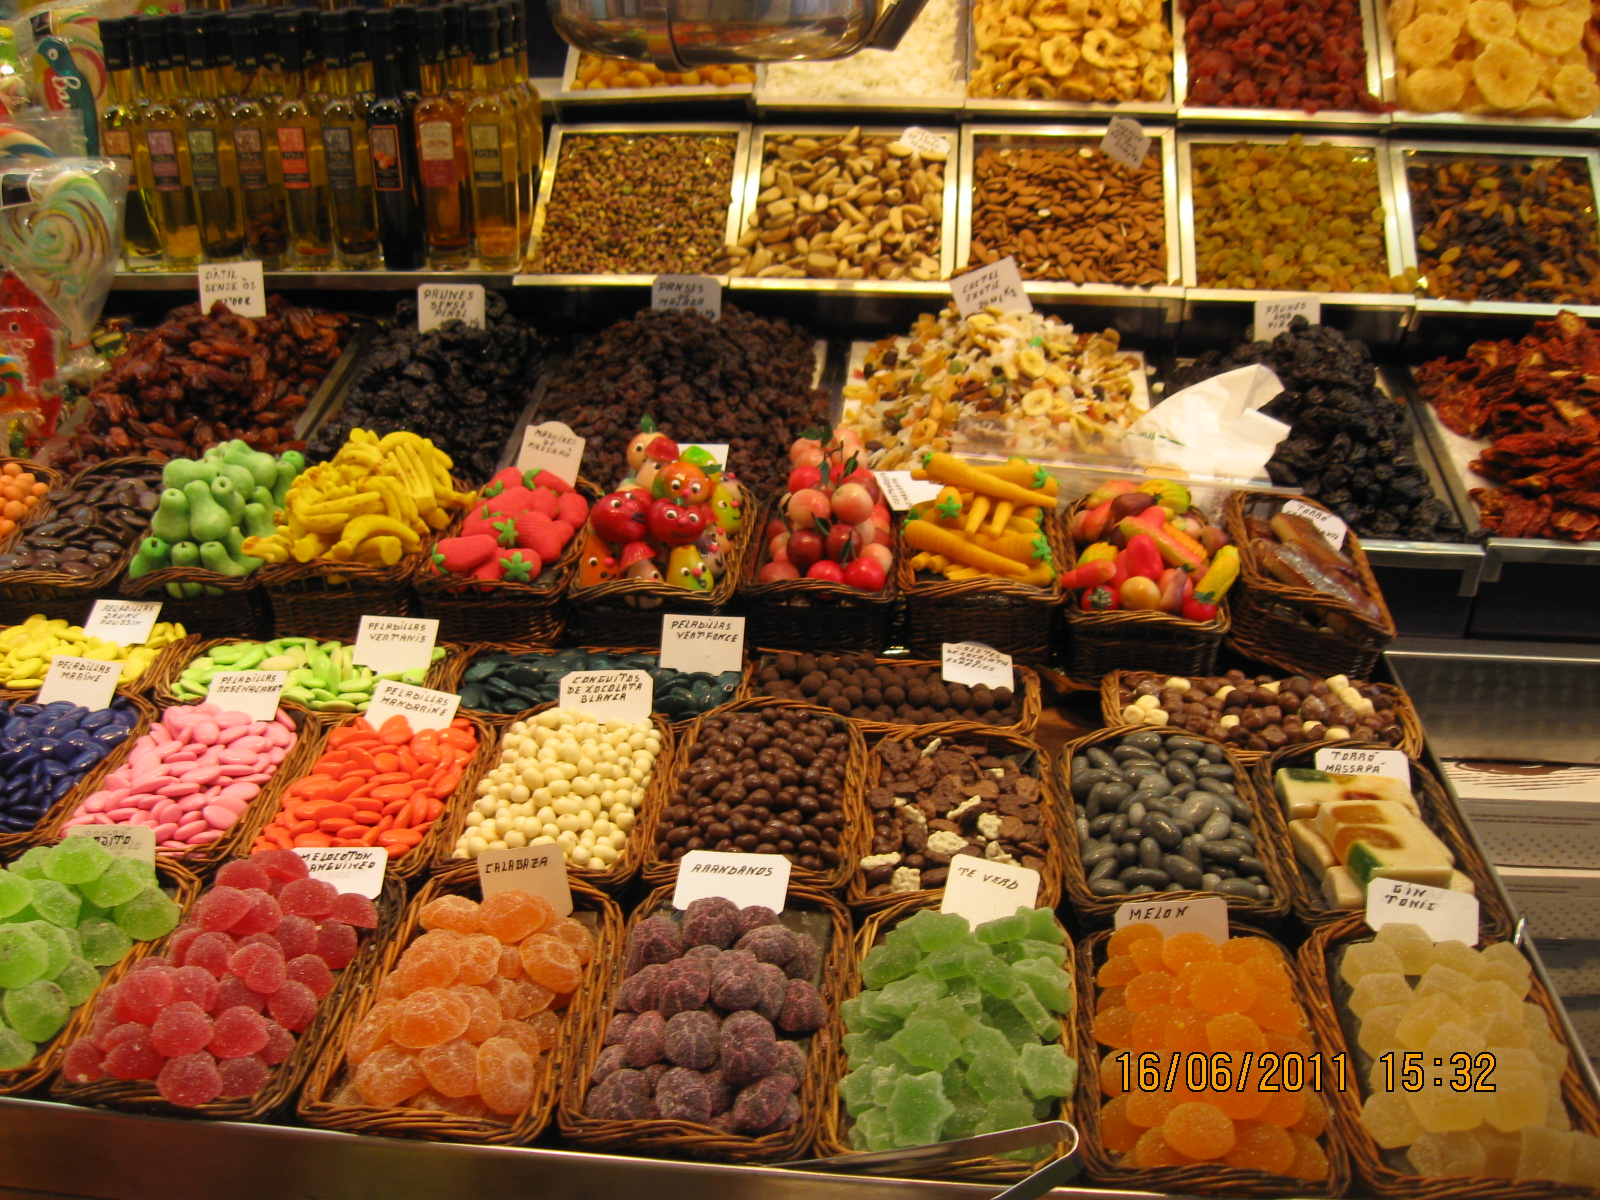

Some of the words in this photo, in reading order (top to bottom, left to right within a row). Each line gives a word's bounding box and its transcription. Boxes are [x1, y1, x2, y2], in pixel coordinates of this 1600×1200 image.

[659, 282, 704, 293] PANSES
[424, 289, 475, 300] PRUNES
[572, 672, 640, 684] CONGUITOS
[567, 686, 581, 695] DE
[585, 682, 643, 694] XOCOLATA
[580, 692, 627, 704] BLANCA
[308, 861, 376, 872] ANGUINEO
[485, 856, 549, 874] CALABAZA
[691, 863, 774, 877] ARANDANOS
[958, 866, 977, 878] TE
[983, 874, 1019, 890] VERD
[1393, 883, 1427, 898] GIN
[1384, 894, 1437, 911] TONIC
[1128, 906, 1189, 921] MELON
